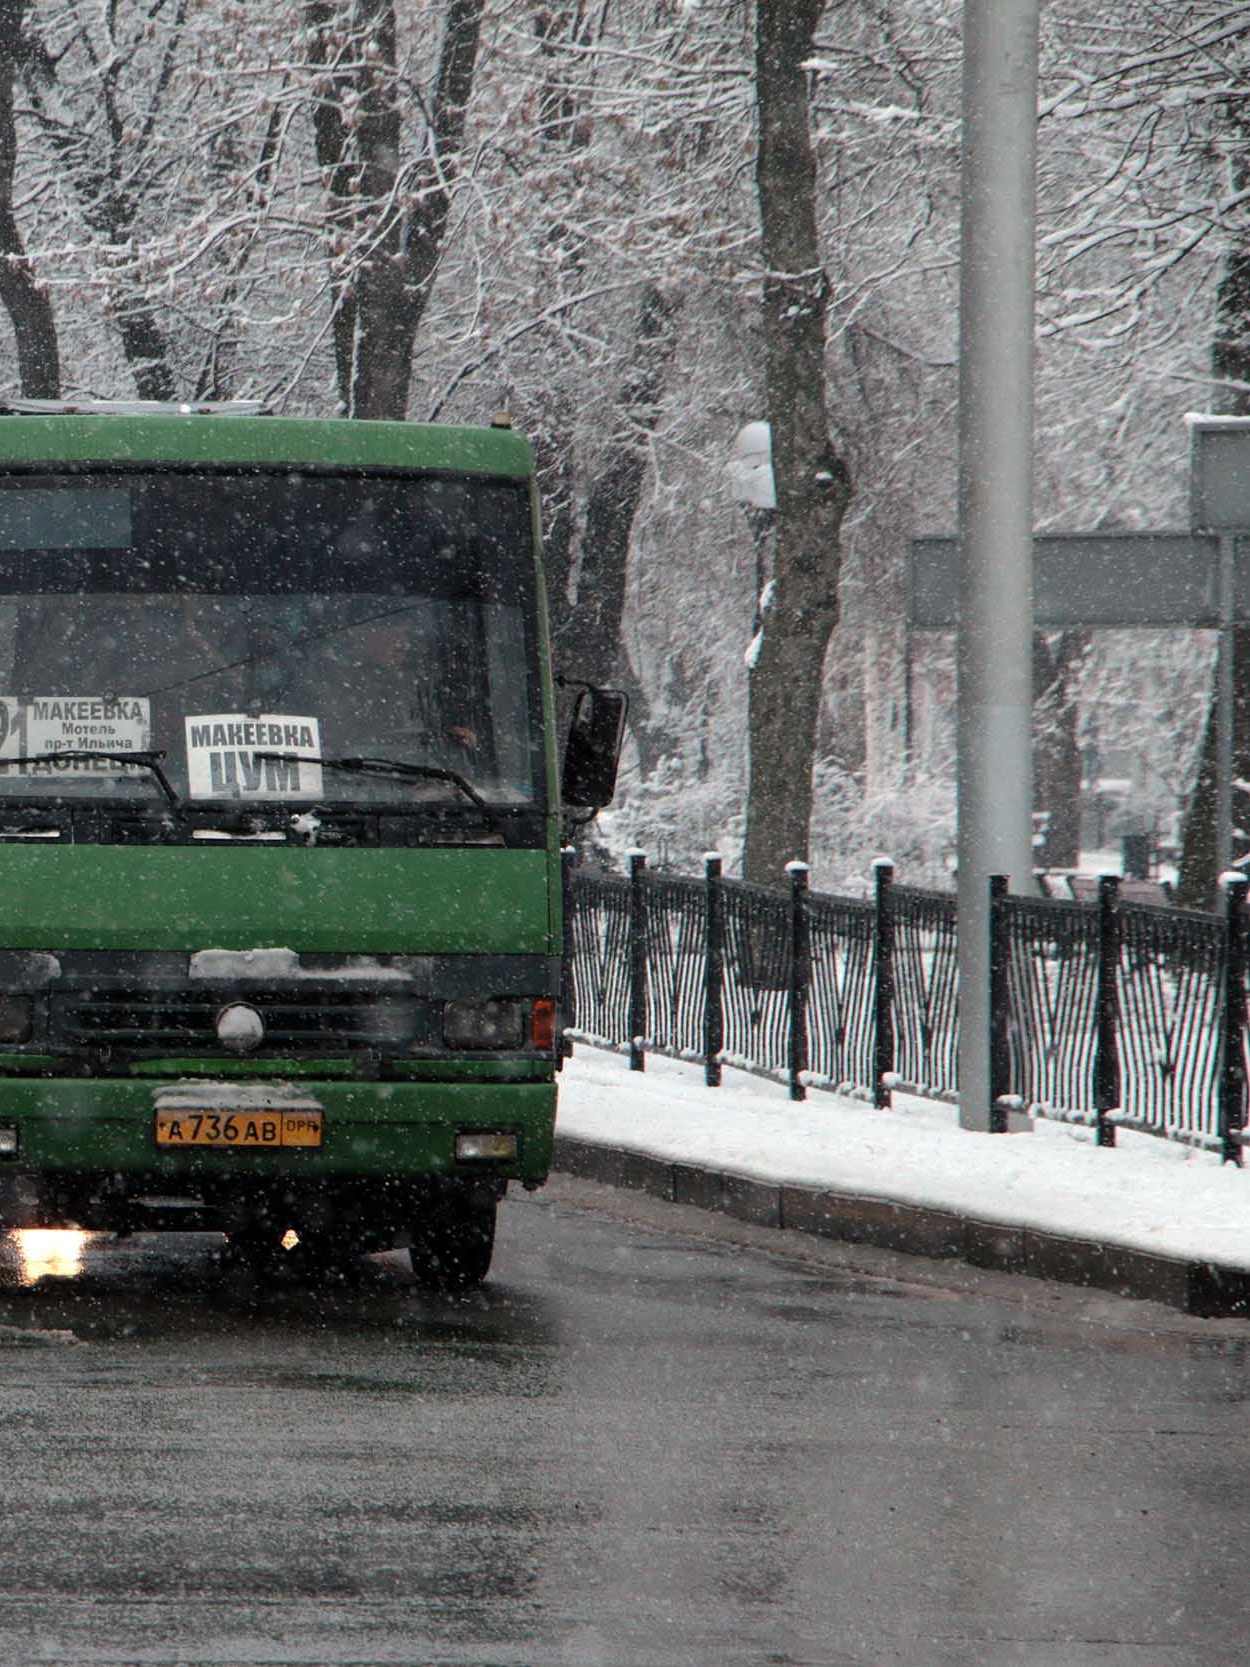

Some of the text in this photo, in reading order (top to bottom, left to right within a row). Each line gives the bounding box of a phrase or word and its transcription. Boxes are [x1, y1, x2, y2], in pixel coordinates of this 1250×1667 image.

[33, 701, 144, 721] МАКЕЕВКА
[61, 722, 117, 736] Мотель
[191, 722, 315, 748] МАКЕЕВКА
[45, 738, 133, 751] пр-т Ильича
[208, 751, 301, 795] ЦУМ
